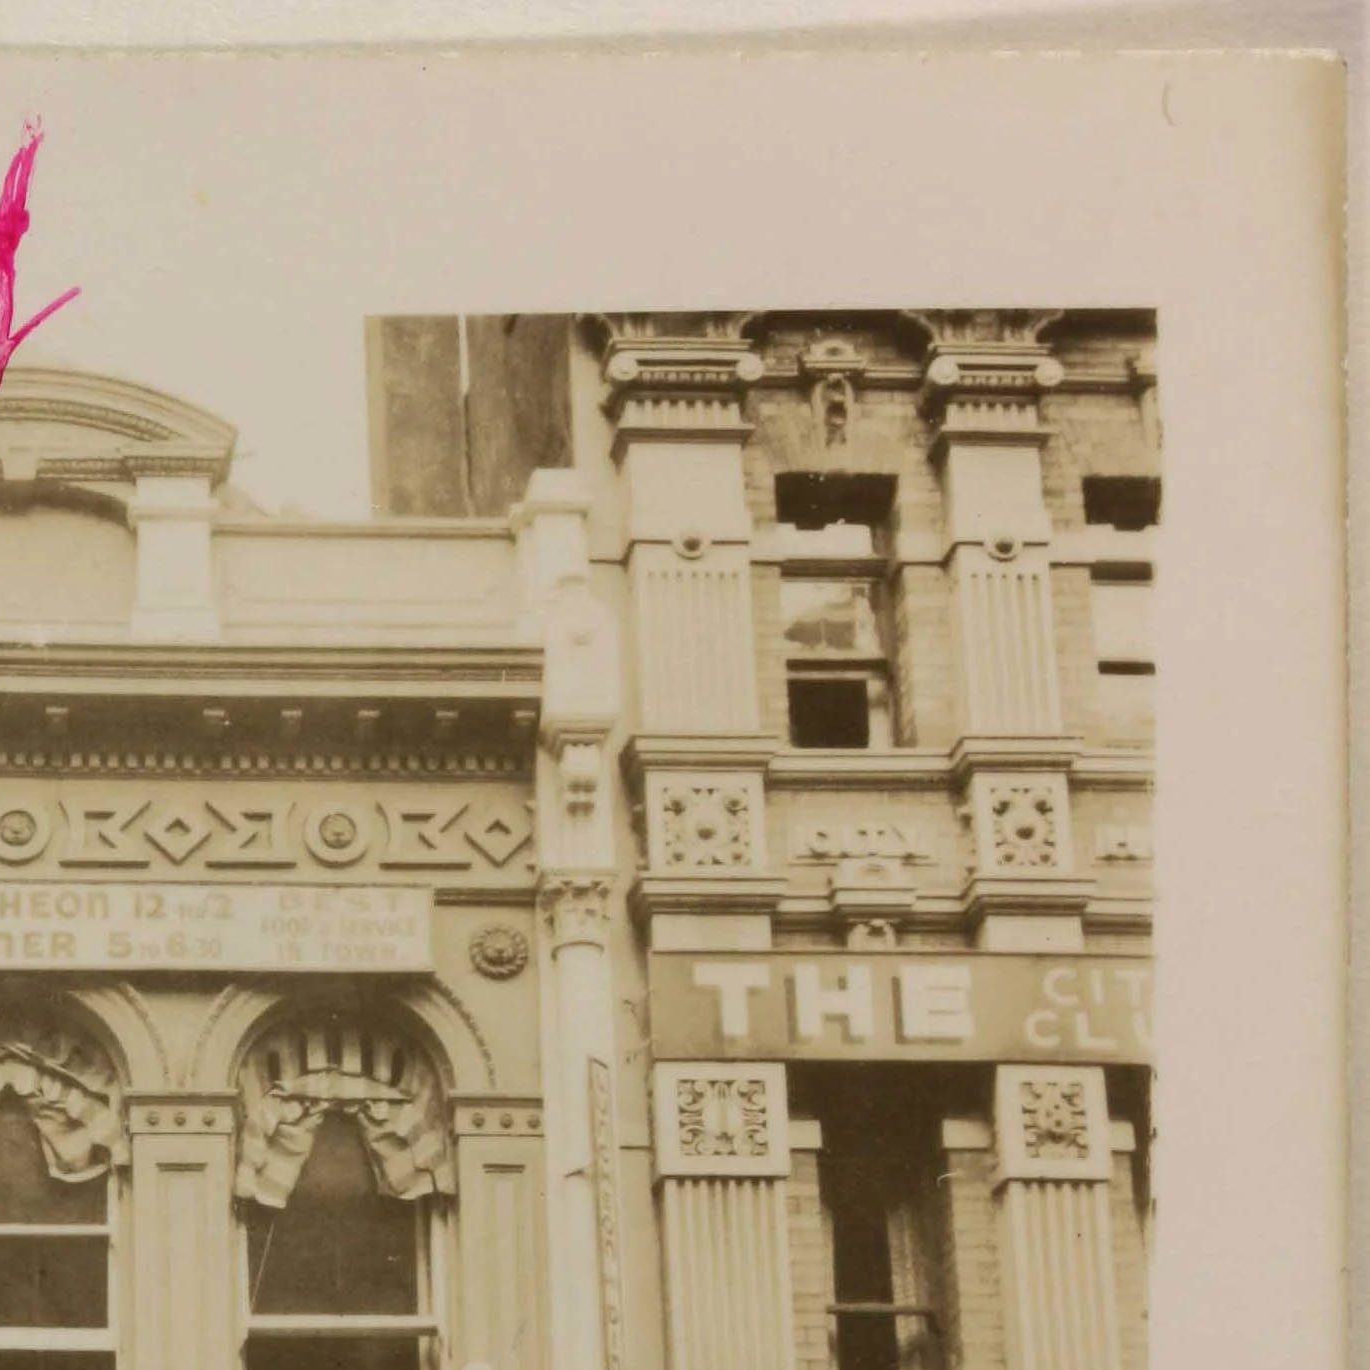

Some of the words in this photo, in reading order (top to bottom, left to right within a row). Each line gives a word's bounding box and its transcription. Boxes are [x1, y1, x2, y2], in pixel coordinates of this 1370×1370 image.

[134, 891, 168, 919] 12
[106, 930, 133, 960] 5
[692, 961, 974, 1041] THE
